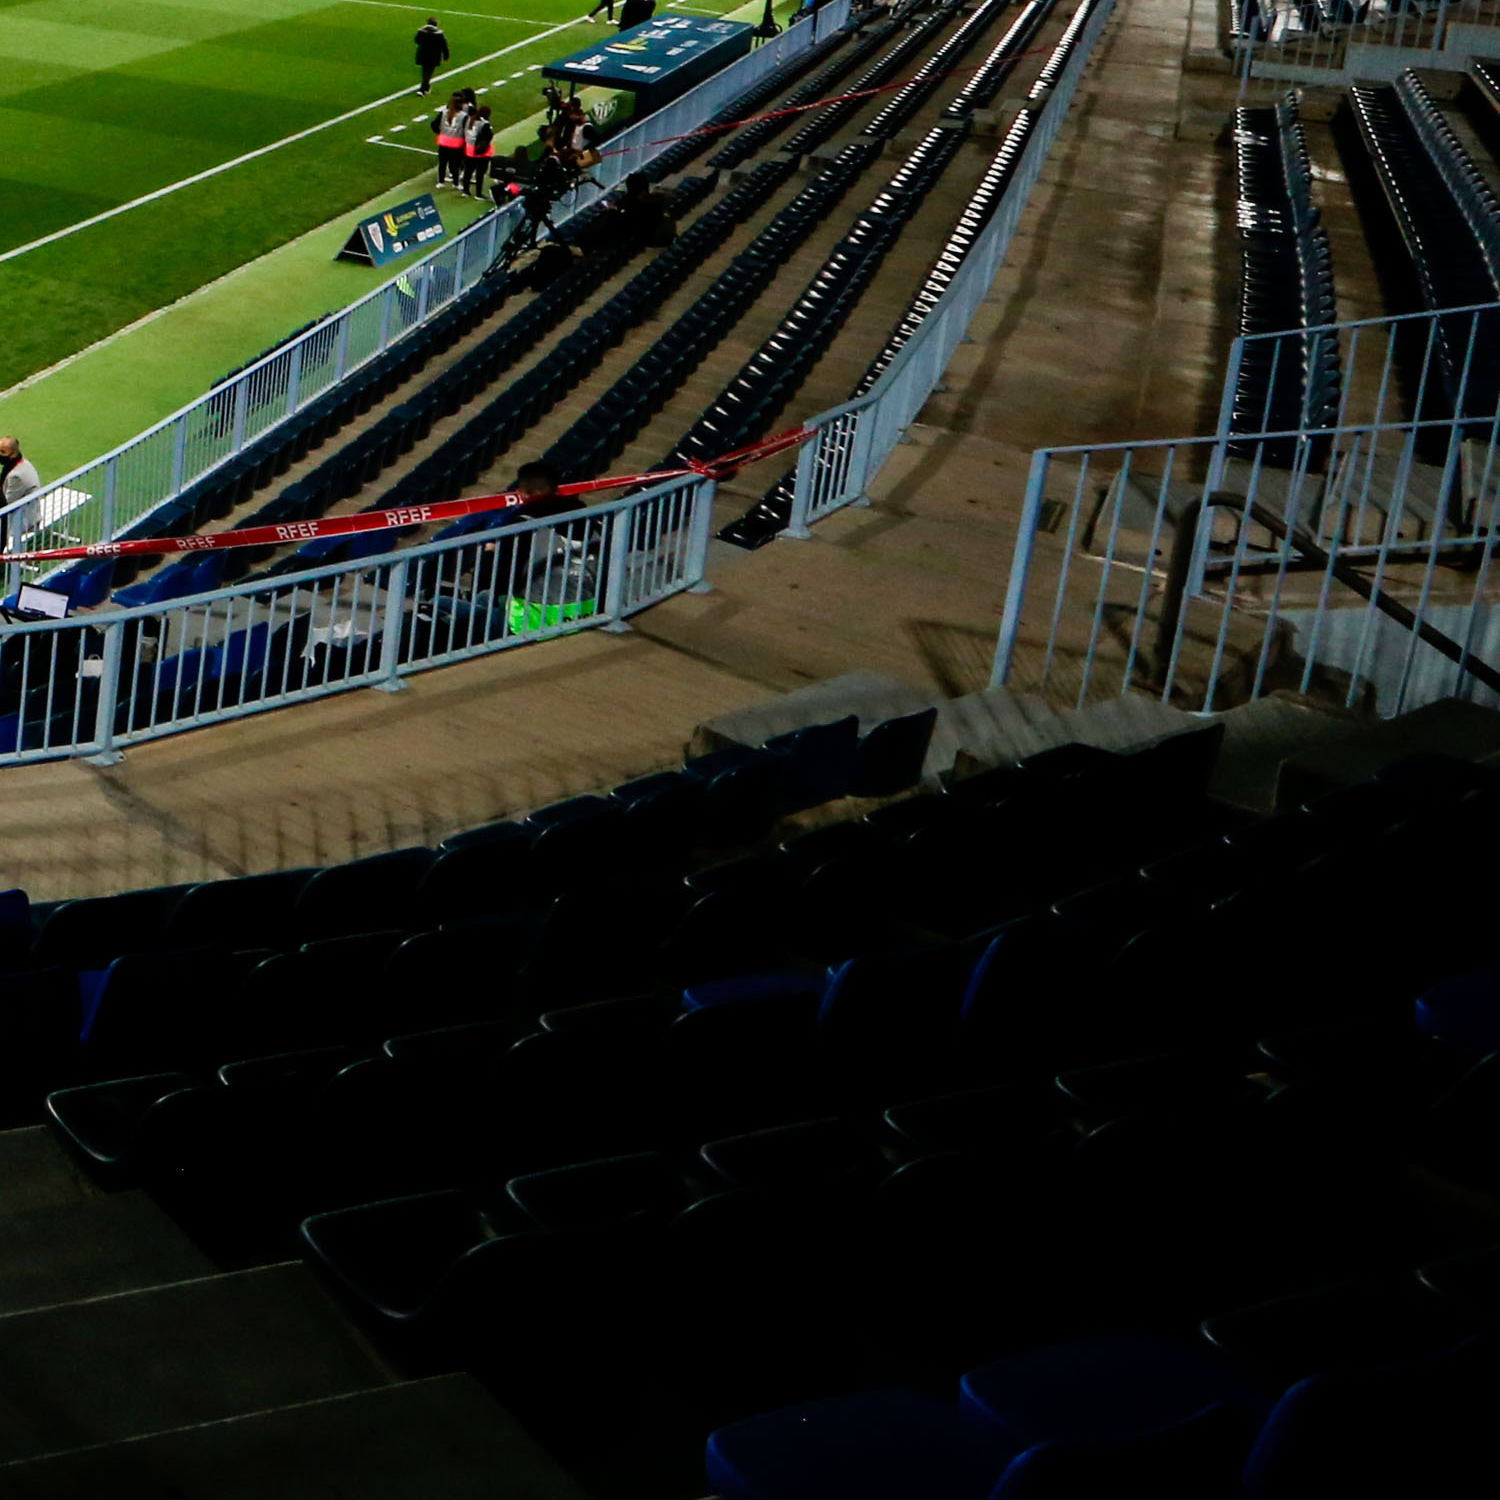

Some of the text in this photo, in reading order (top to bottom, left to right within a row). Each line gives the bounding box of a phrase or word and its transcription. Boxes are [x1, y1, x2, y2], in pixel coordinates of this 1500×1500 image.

[385, 506, 432, 527] RFEF
[276, 522, 320, 541] RFEF
[176, 536, 216, 551] RFEF
